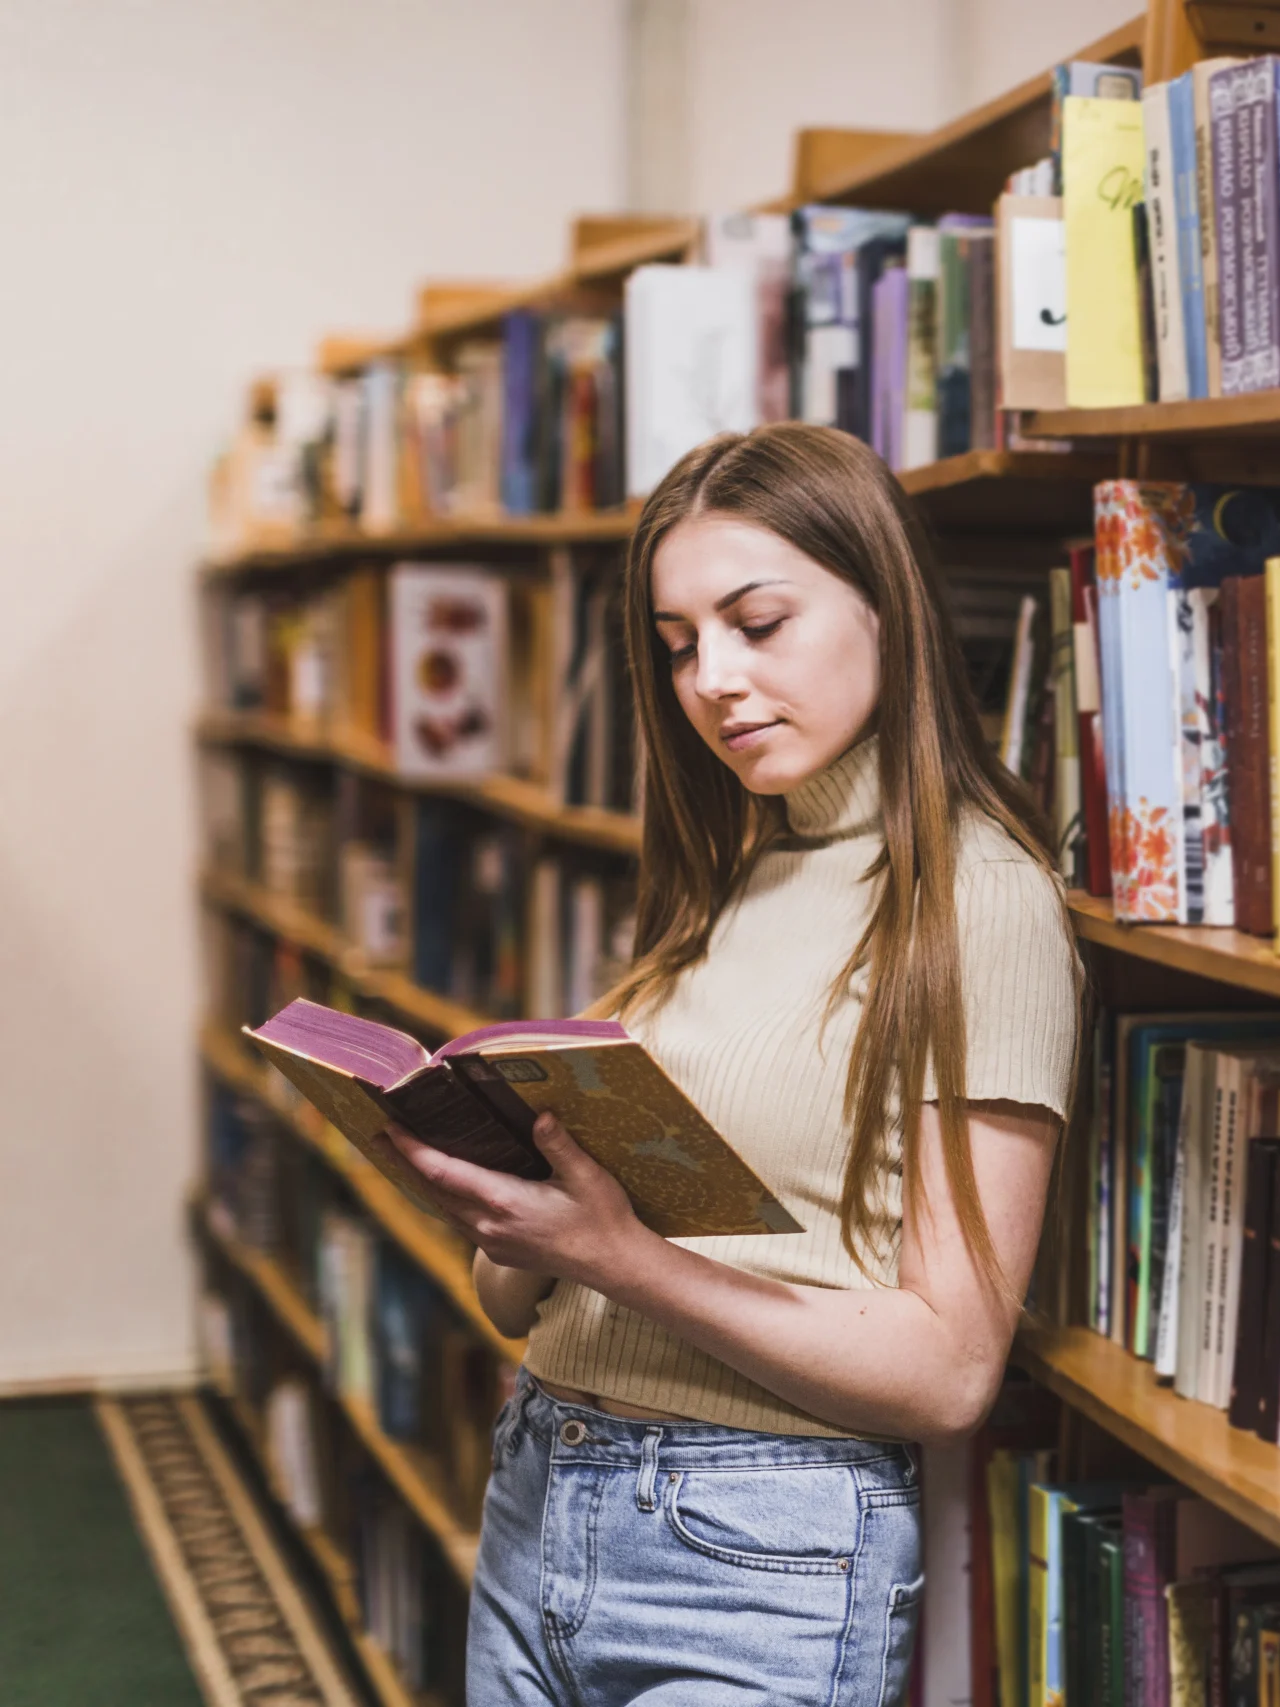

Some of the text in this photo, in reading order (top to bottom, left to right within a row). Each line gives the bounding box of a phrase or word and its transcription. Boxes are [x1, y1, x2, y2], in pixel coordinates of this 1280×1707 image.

[1237, 108, 1253, 188] КИРИЛО
[1217, 117, 1241, 358] КИРИЛО РОЗУМОВСЬКИЙ
